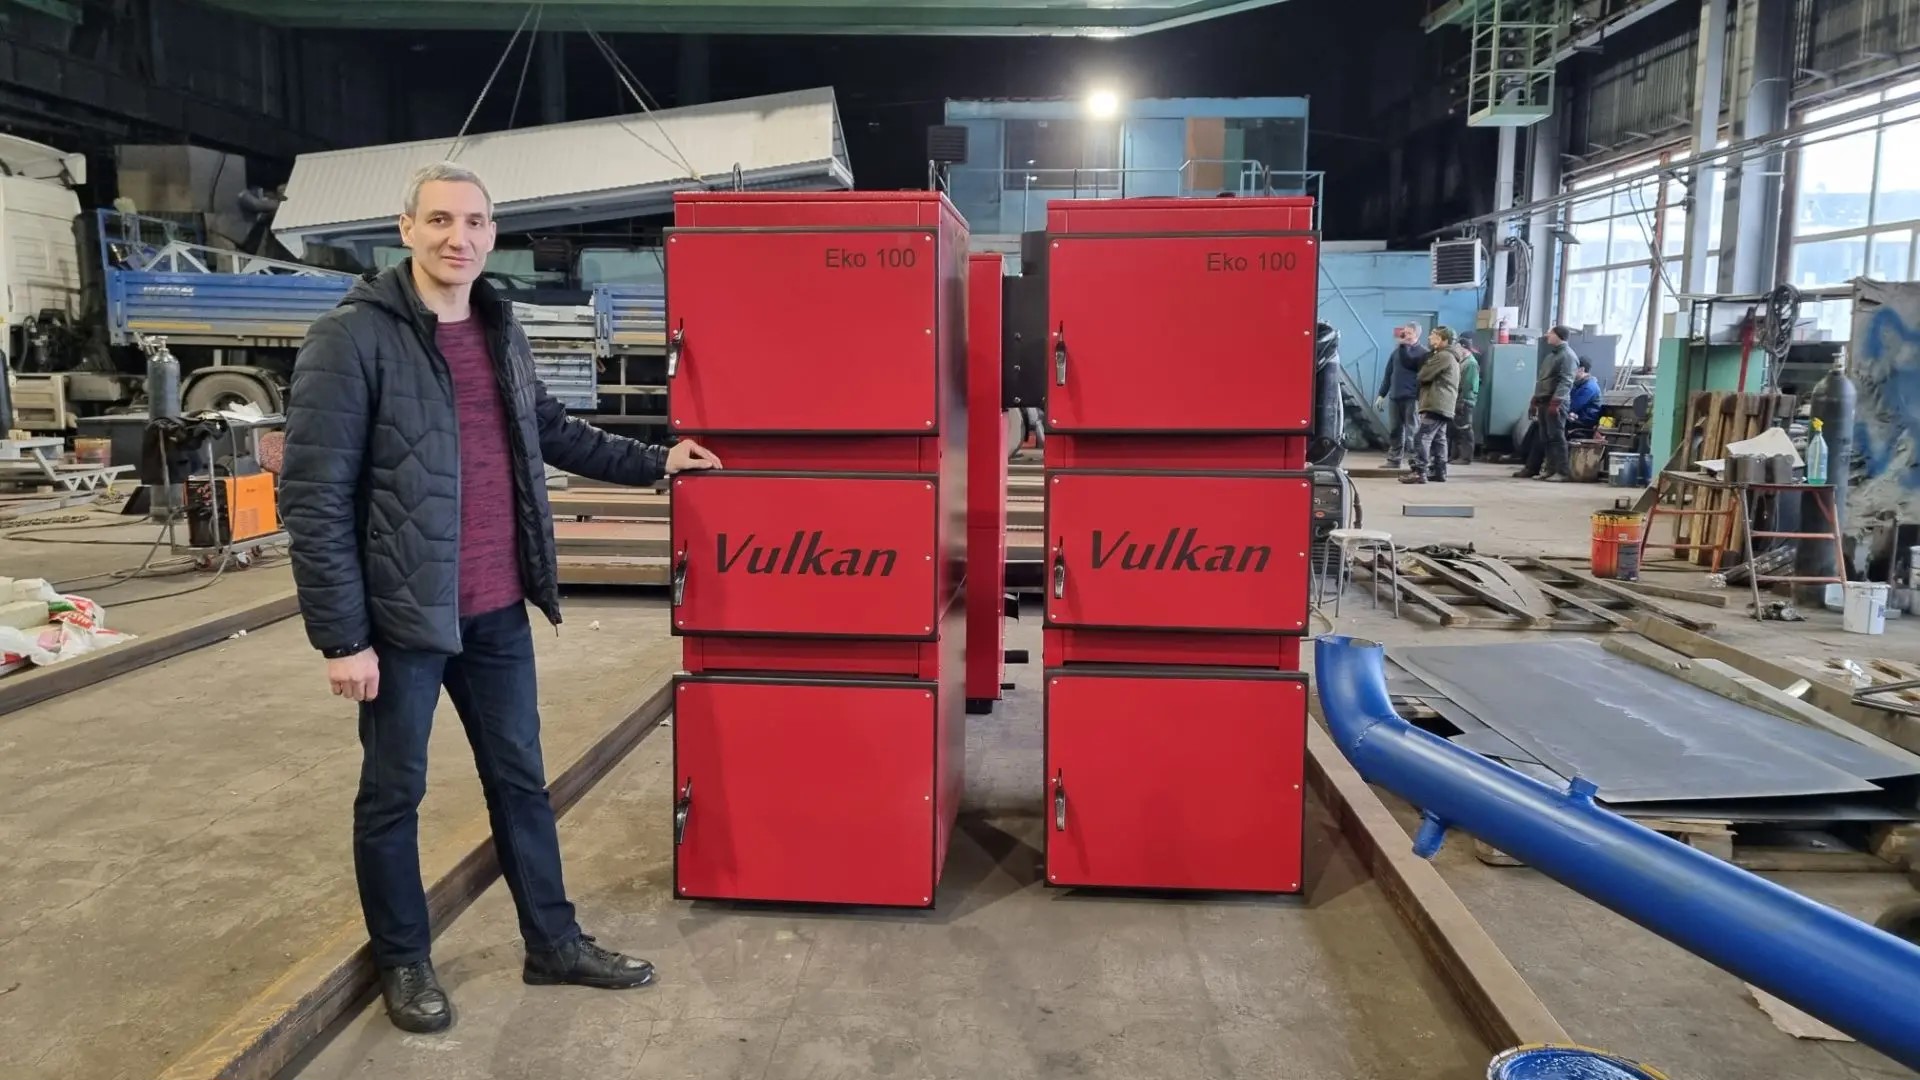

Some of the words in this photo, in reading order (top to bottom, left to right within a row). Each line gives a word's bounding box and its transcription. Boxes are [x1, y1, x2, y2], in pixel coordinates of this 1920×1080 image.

[825, 248, 867, 268] Eko
[877, 248, 916, 268] 100
[1207, 252, 1249, 271] Eko
[1259, 252, 1297, 271] 100
[716, 531, 898, 577] Vulkan
[1091, 527, 1271, 573] Vulkan
